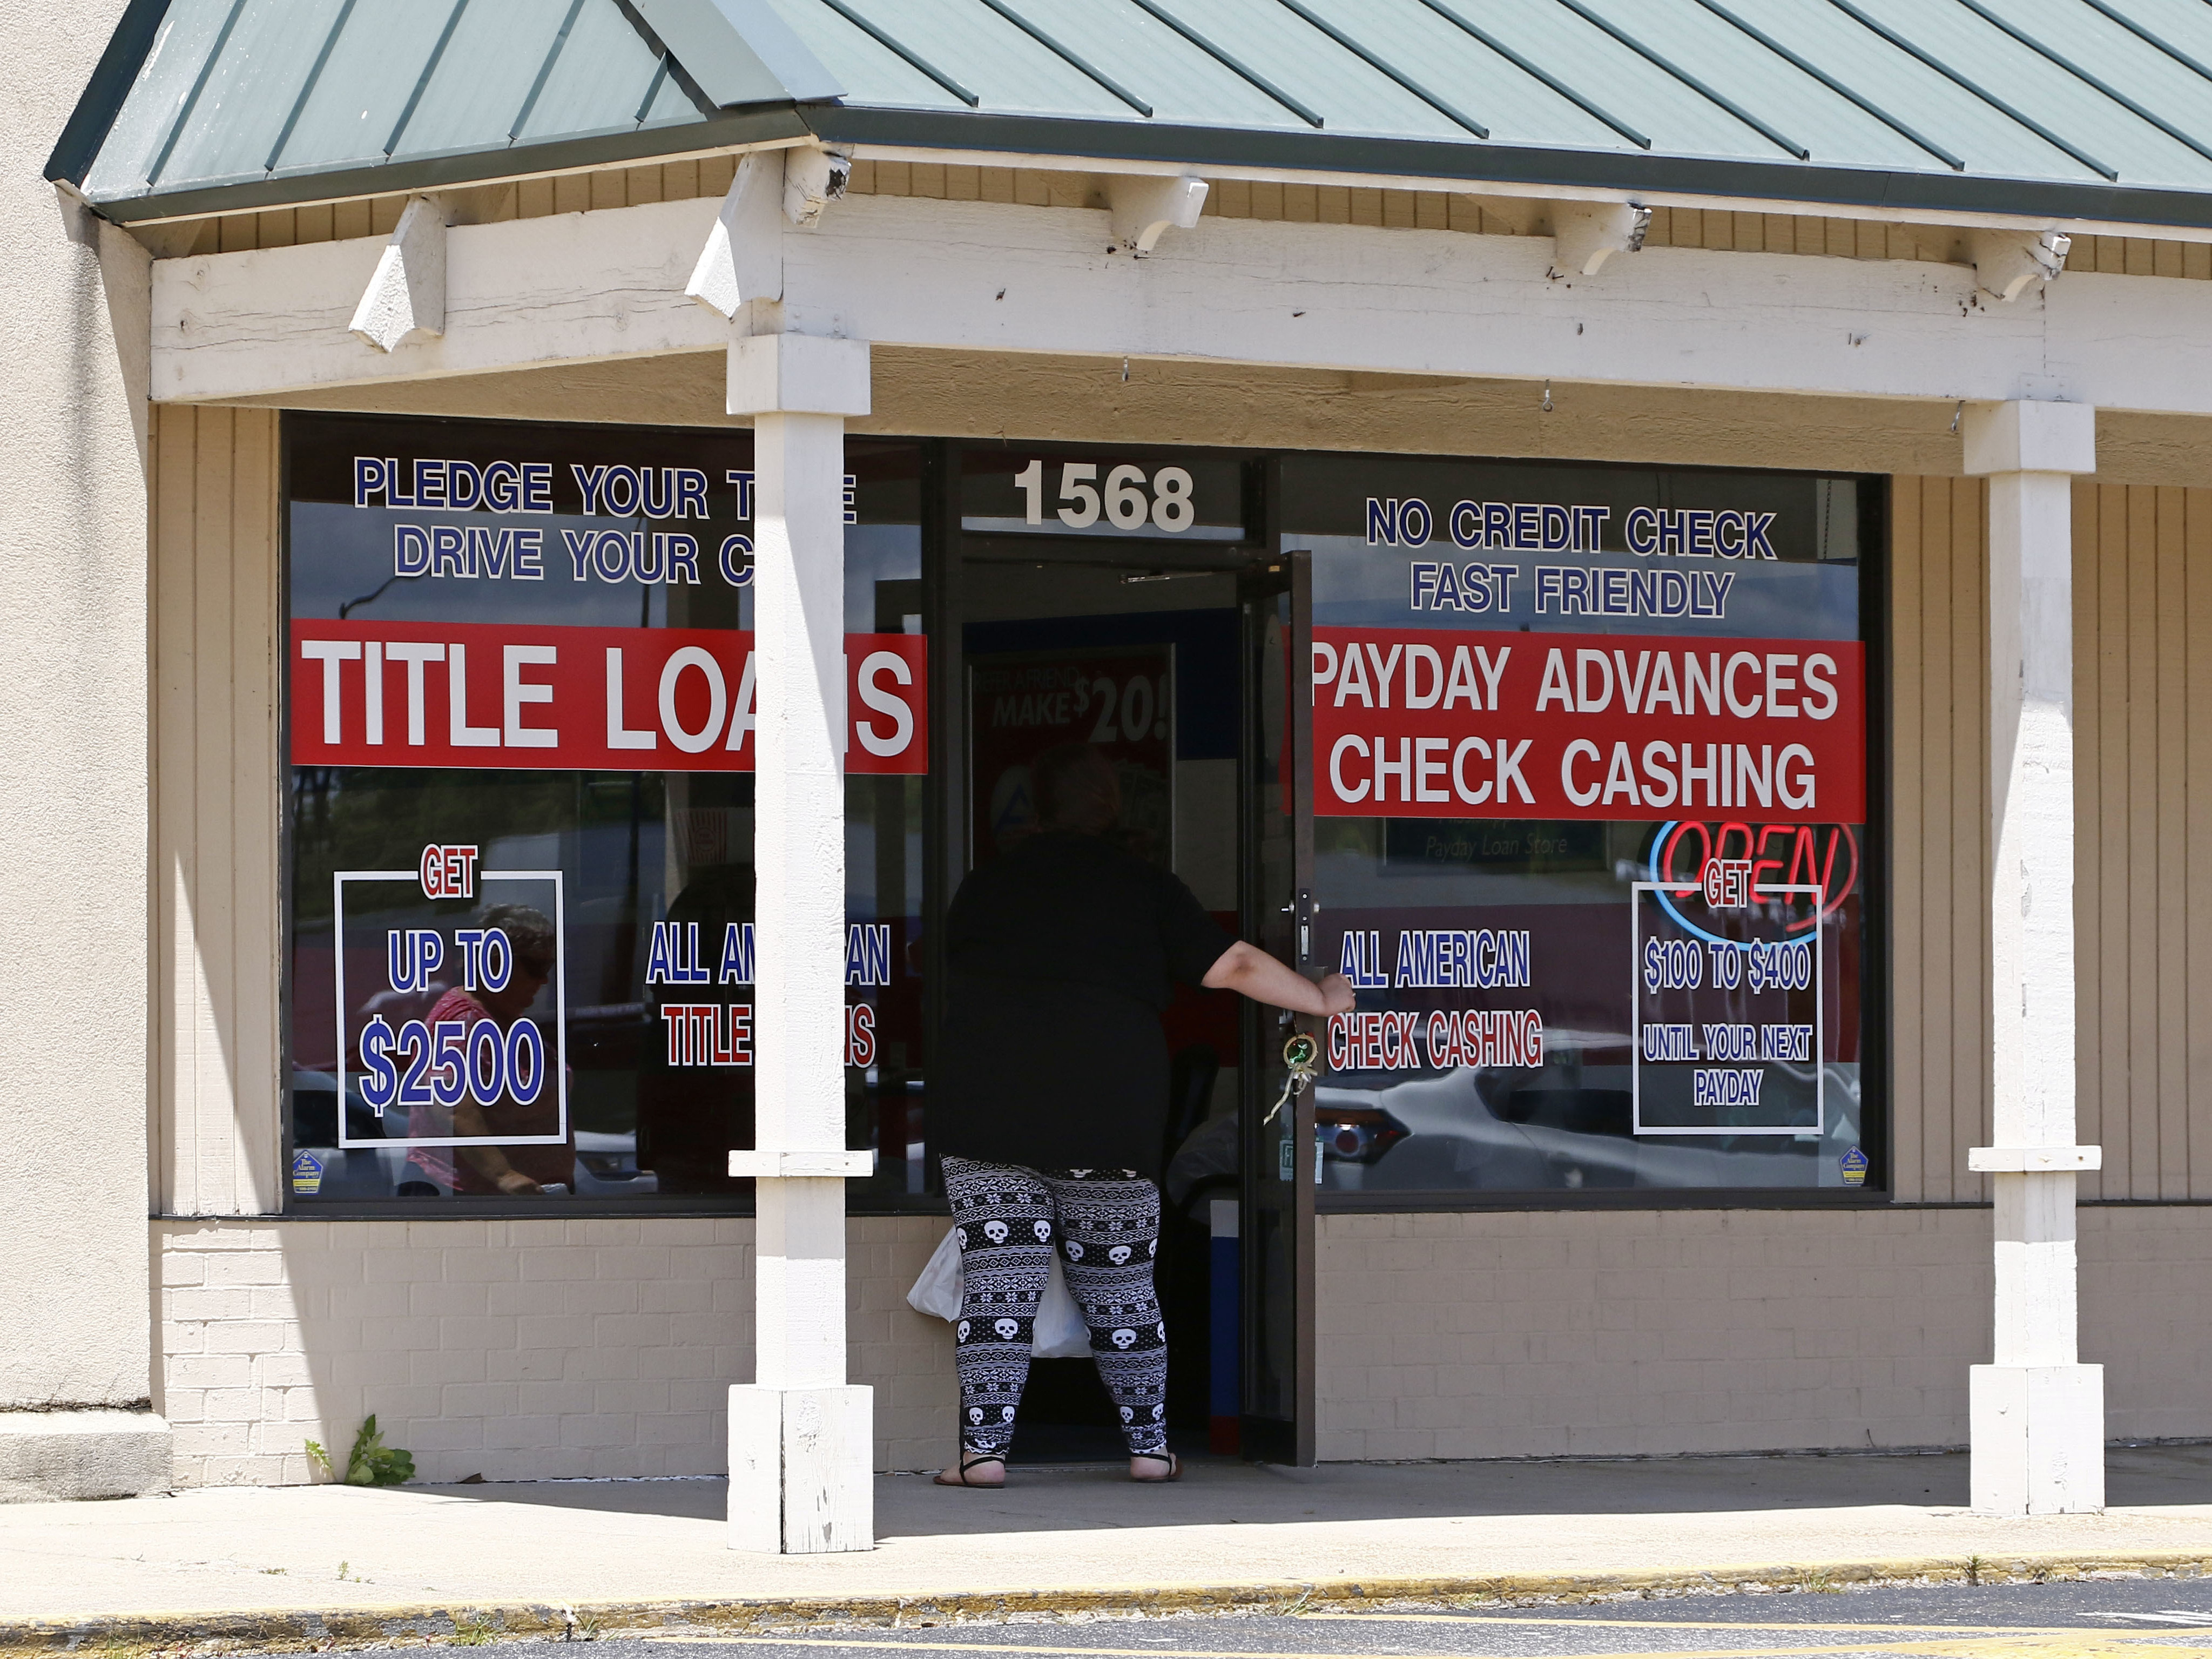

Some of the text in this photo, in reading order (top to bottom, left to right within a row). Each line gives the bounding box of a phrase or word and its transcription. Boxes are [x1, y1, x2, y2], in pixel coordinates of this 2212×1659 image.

[354, 456, 552, 514] PLEDGE
[570, 463, 710, 520] YOUR
[1015, 460, 1195, 532] 1568
[395, 524, 543, 580] DRIVE
[560, 529, 701, 585] YOUR
[1366, 497, 1777, 559] NO CREDIT CHECK
[1410, 561, 1735, 618] FAST FRIENDLY
[301, 640, 914, 757] TITLE LOS
[992, 692, 1070, 727] MAKE
[1312, 642, 1838, 720] PAYDAY ADVANCES
[1330, 734, 1815, 810] CHECK CASHING
[420, 844, 478, 900] GET
[1426, 832, 1568, 862] Payday Loan Store
[1663, 821, 1839, 905] OPEN
[1704, 858, 1752, 908] GET
[388, 927, 512, 993] UP TO
[645, 921, 710, 984] ALL
[1340, 928, 1530, 989] ALL AMERICAN
[1644, 936, 1810, 994] $100 TO $400
[661, 1003, 752, 1065] TITLE
[1327, 1009, 1543, 1071] CHECK CASHING
[1643, 1023, 1812, 1061] UNTIL YOUR NEXT
[358, 1014, 544, 1117] $2500
[1694, 1069, 1764, 1106] PAYDAY
[293, 1170, 320, 1178] Company
